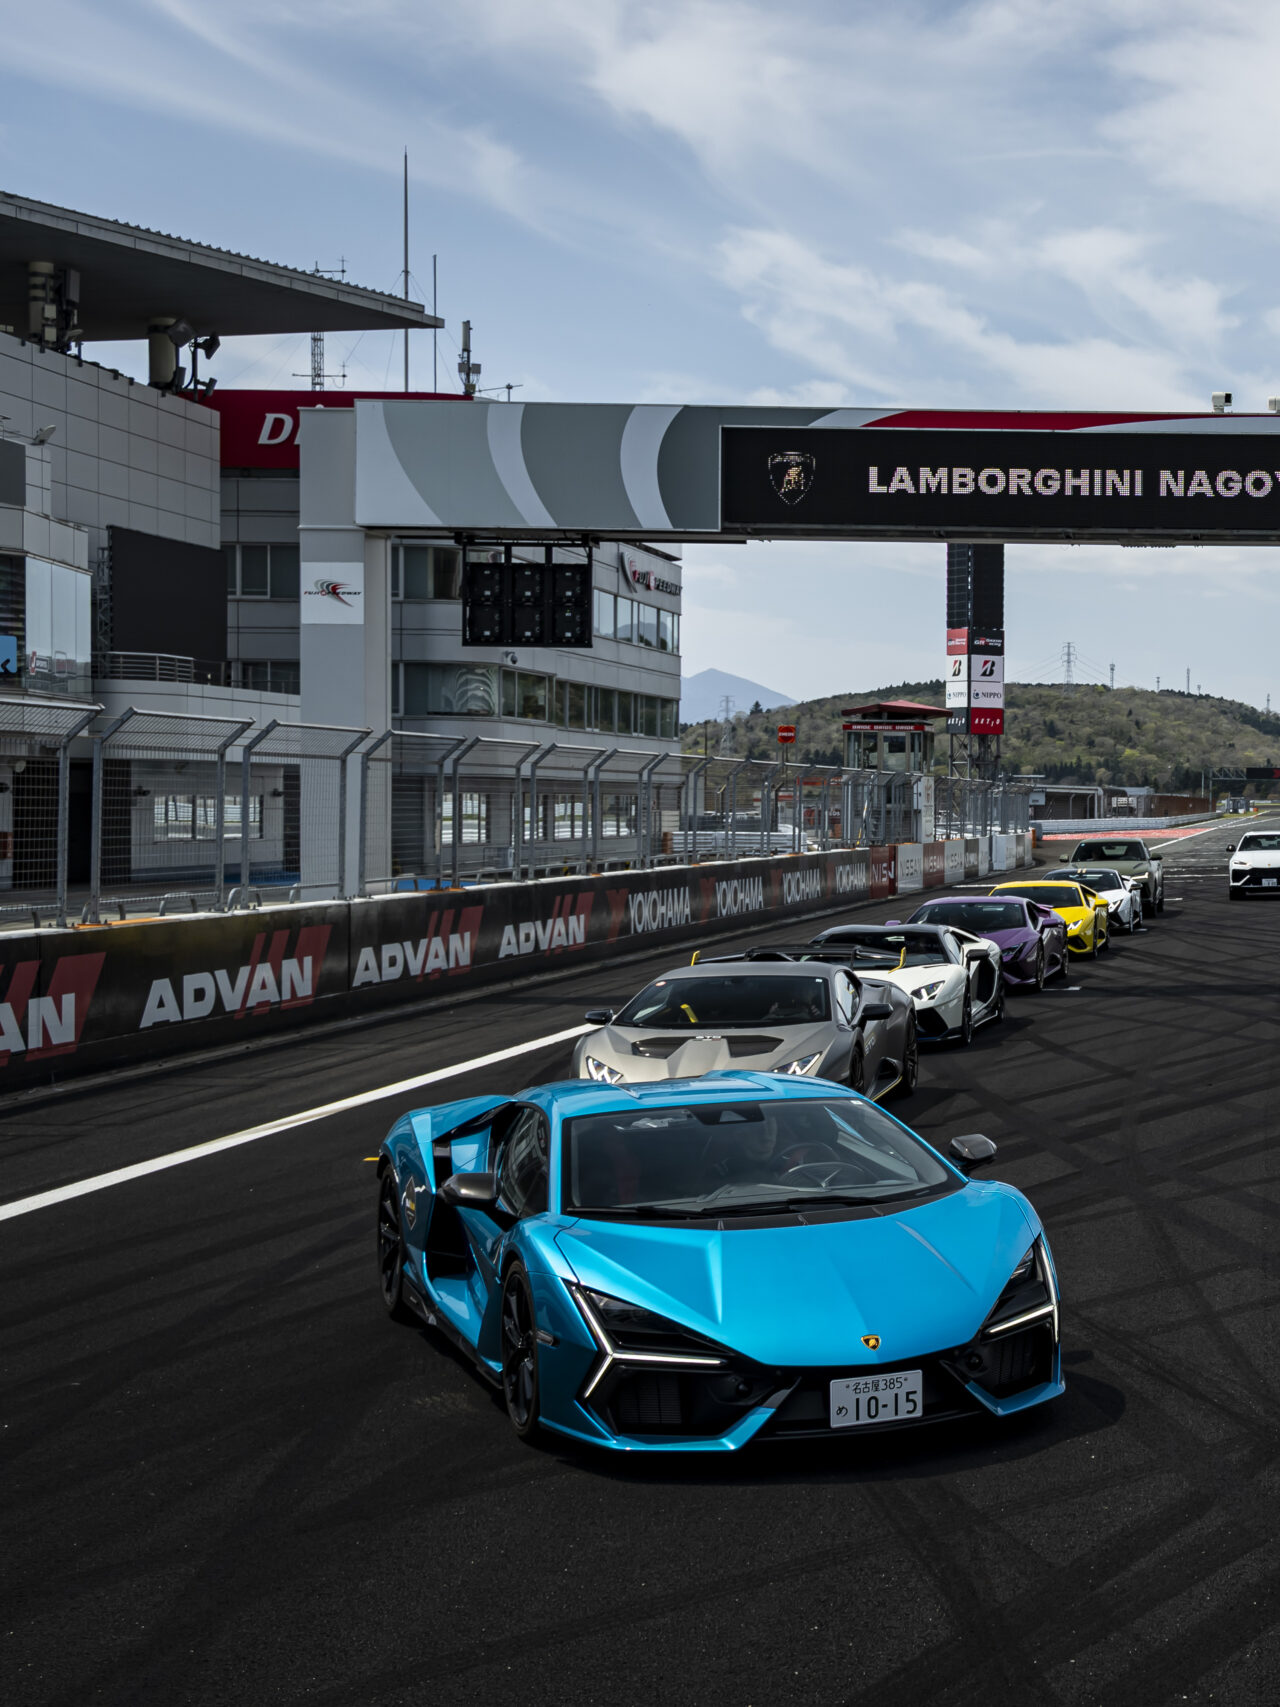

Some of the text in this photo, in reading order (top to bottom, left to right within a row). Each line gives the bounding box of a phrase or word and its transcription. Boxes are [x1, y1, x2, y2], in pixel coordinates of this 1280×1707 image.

[257, 413, 300, 445] D
[868, 466, 1143, 496] LAMBORGHINI
[715, 876, 764, 917] YOKOHAMA
[783, 868, 821, 905] YOKOHAMA
[835, 863, 867, 894] YOKOHAMA
[628, 886, 692, 935] YOKOHAMA
[498, 914, 586, 959] ADVAN
[352, 931, 471, 988] ADVAN
[139, 956, 313, 1029] ADVAN
[881, 1377, 903, 1391] 385
[855, 1391, 918, 1421] 10-15
